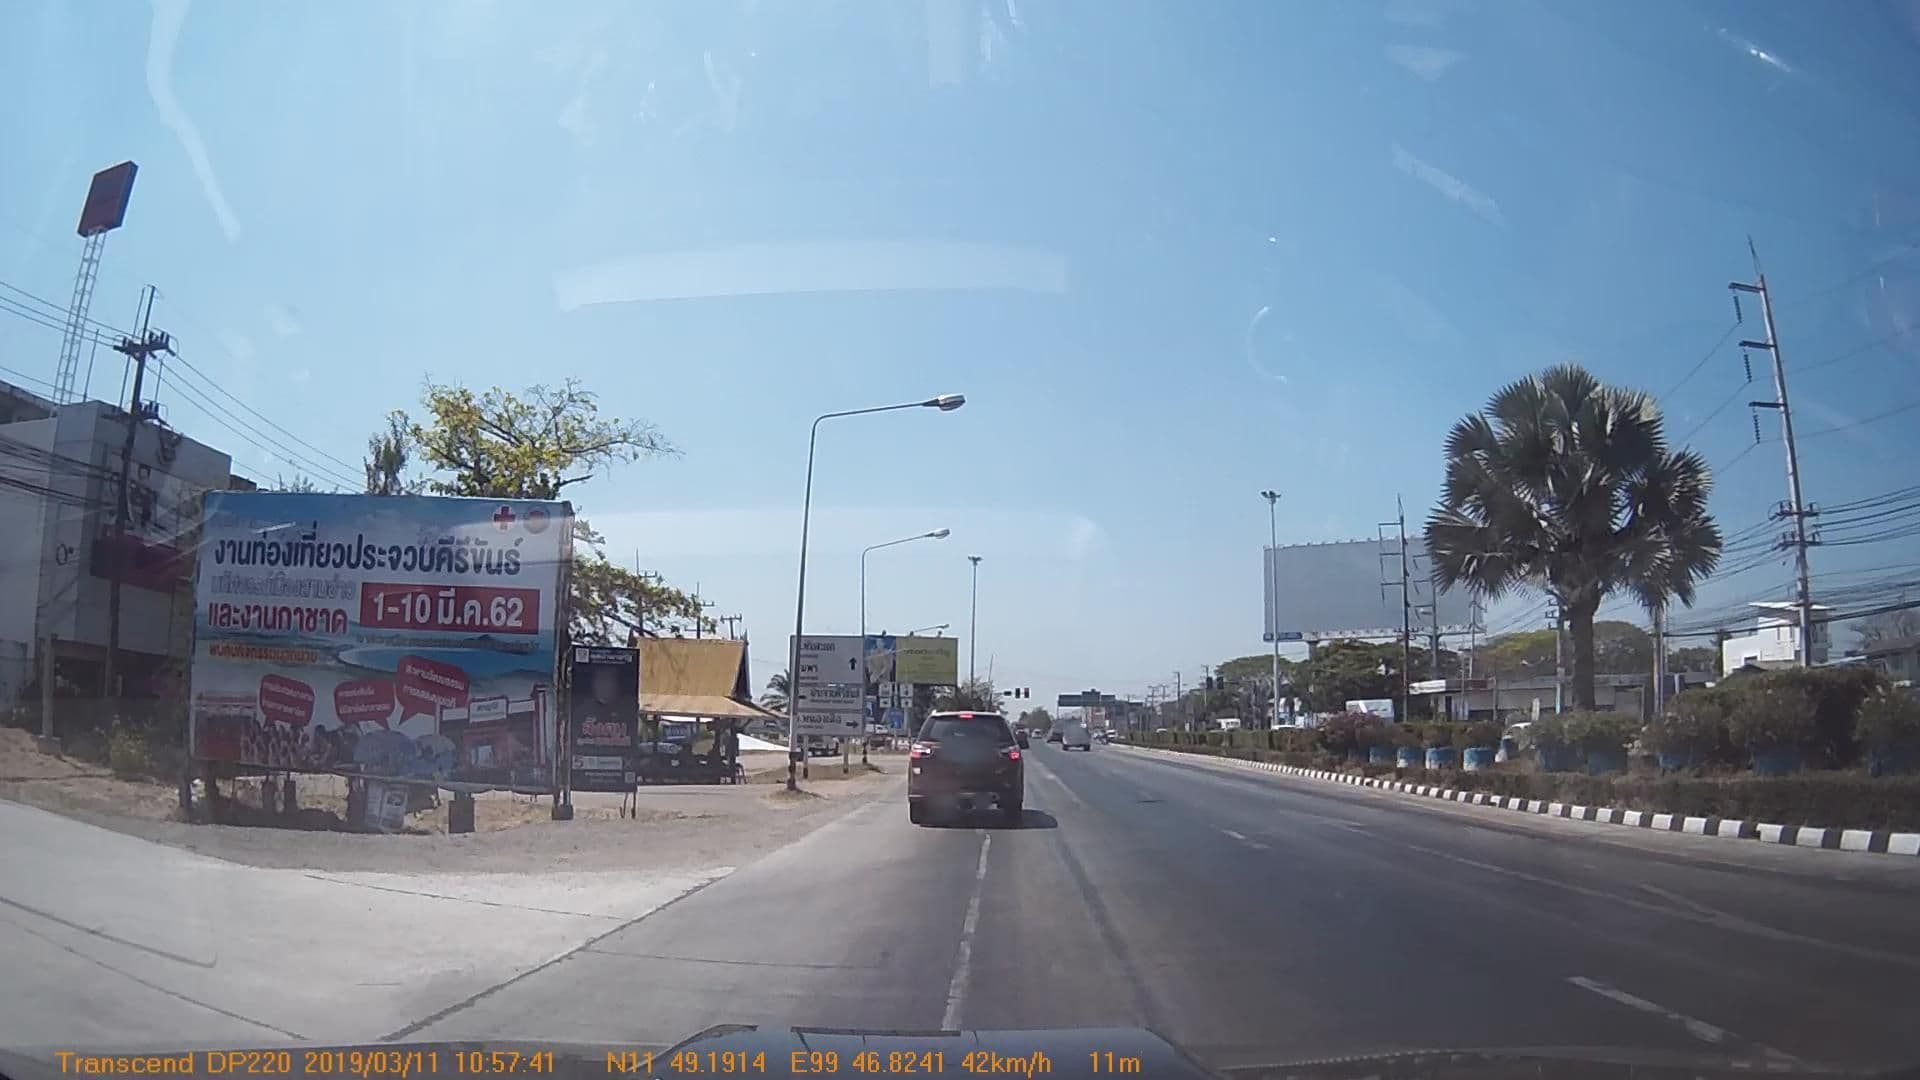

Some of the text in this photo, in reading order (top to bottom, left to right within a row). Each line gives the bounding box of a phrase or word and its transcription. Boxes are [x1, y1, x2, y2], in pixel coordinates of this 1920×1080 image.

[213, 521, 524, 577] งานท่องเที่ยวประจวบคีรีขันธ์
[208, 602, 348, 635] และงานกาชาด
[373, 588, 524, 627] 1-10 มี.ค.62
